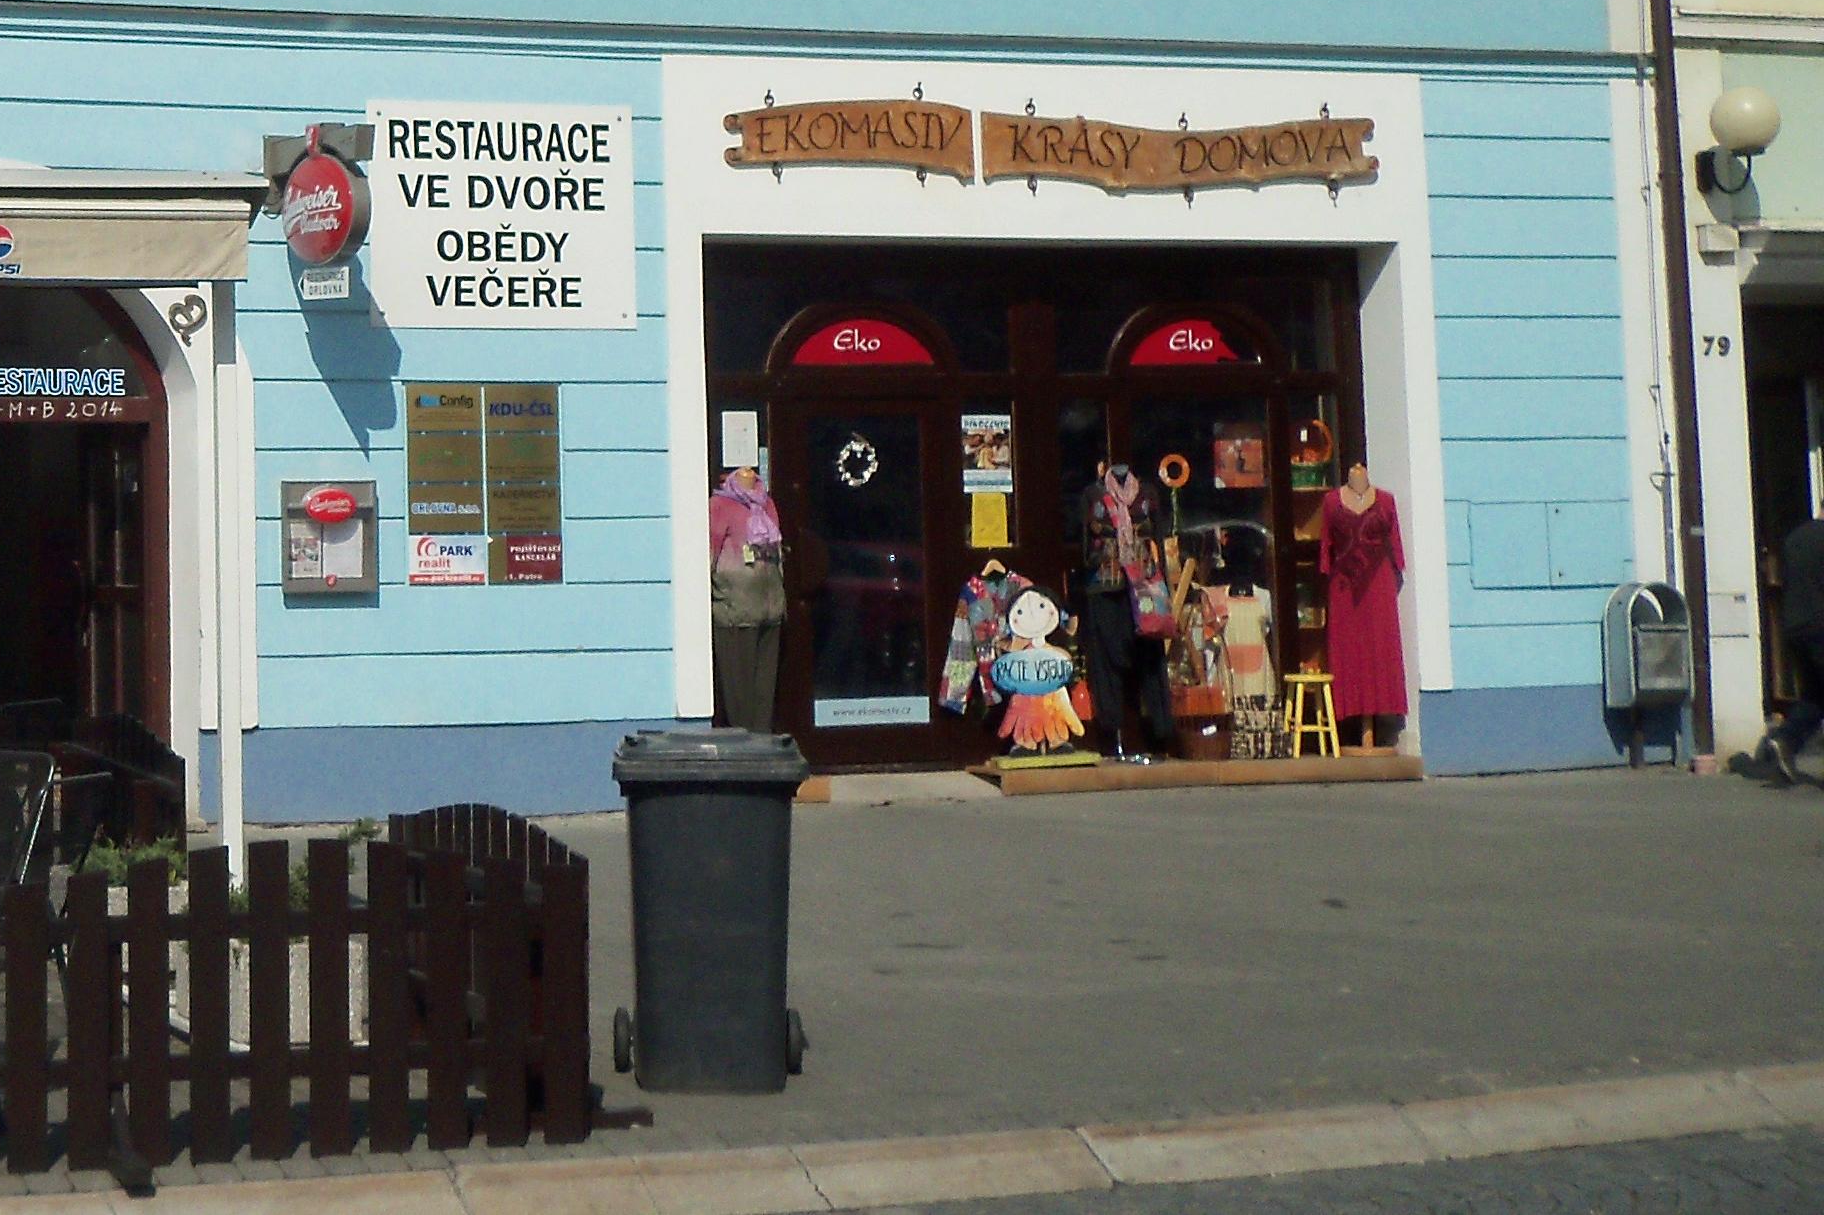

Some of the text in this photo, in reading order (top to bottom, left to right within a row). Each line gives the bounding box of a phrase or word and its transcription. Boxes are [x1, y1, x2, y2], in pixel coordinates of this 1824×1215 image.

[388, 119, 610, 163] RESTAURACE
[754, 110, 964, 155] EKOMASIV
[1176, 128, 1352, 175] DOMOVA
[397, 168, 606, 211] VE DVOŘE
[436, 223, 570, 263] OBĚDY
[426, 267, 582, 308] VEČEŘE
[833, 329, 881, 352] Eko
[1169, 330, 1213, 352] Eko
[1702, 336, 1731, 356] 79
[65, 401, 122, 419] 2014
[489, 400, 553, 417] KDU-ČSL
[440, 545, 473, 556] PARK
[418, 558, 451, 568] realit
